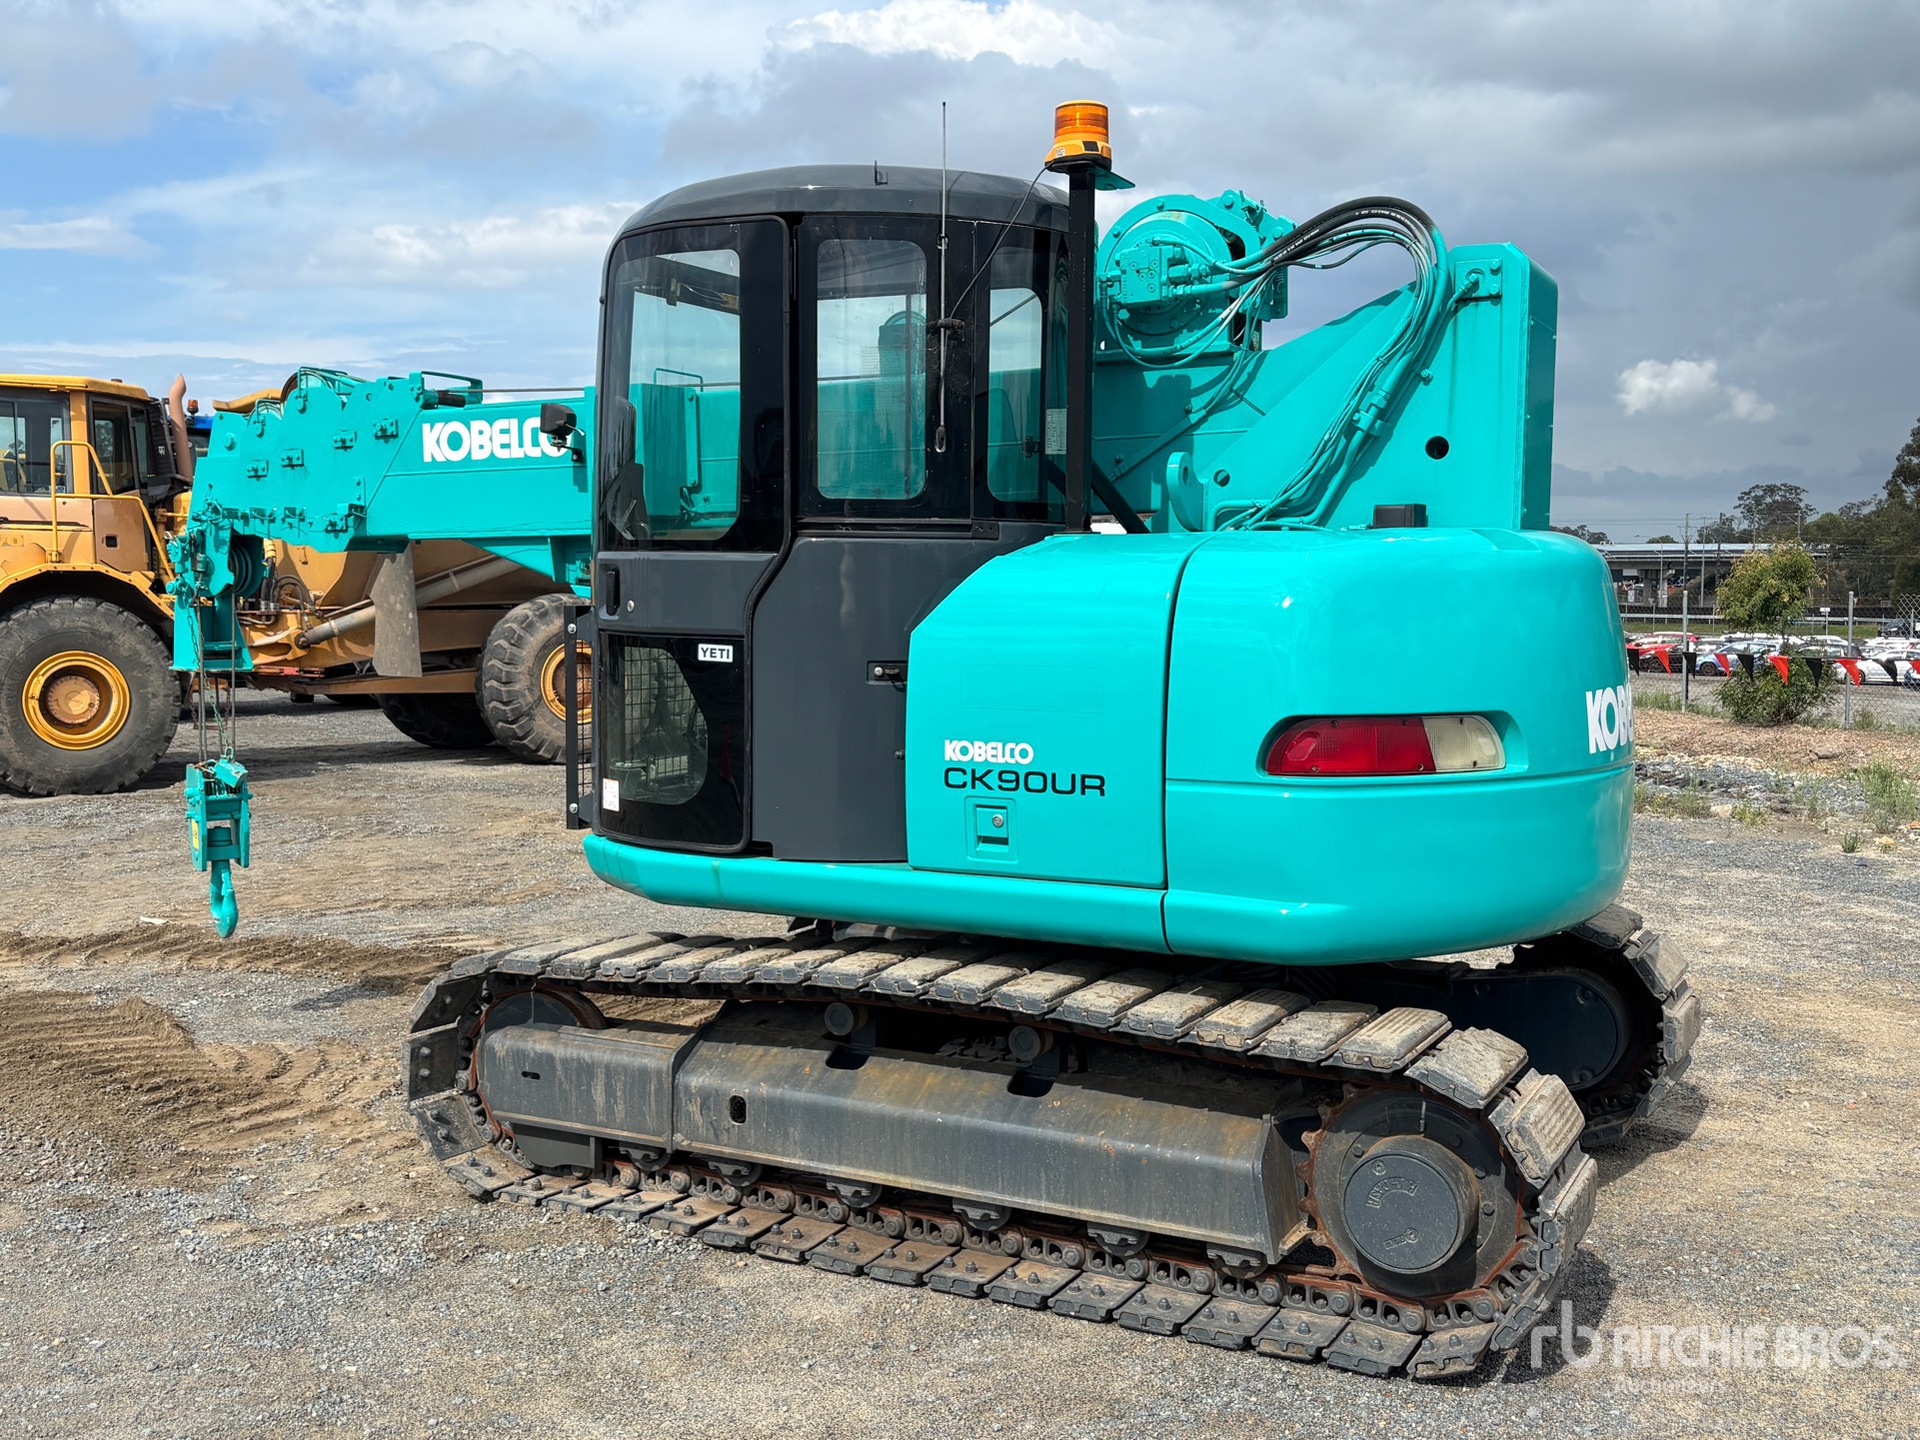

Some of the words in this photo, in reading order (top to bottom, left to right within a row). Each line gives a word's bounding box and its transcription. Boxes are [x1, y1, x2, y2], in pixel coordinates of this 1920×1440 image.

[422, 416, 572, 463] KOBELCO
[700, 647, 730, 660] YETI
[944, 739, 1034, 765] KOBELCO
[944, 767, 1106, 797] CK90UR
